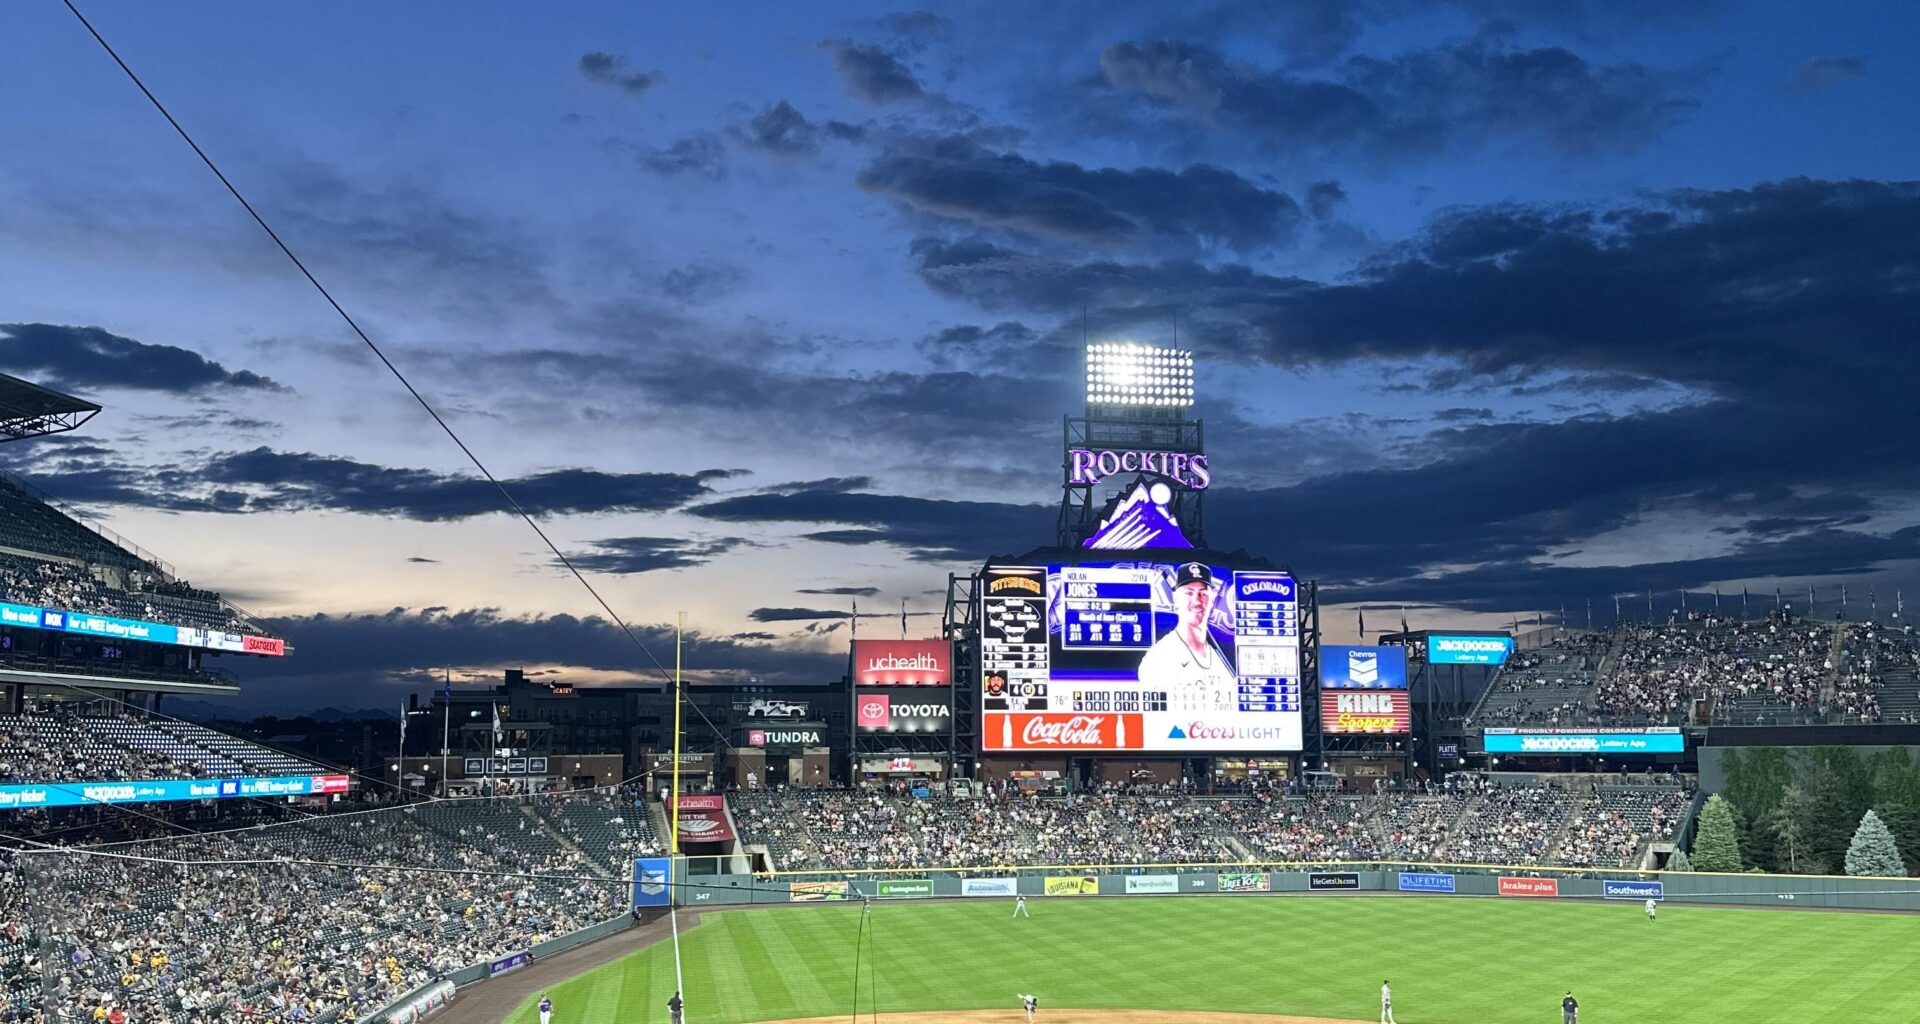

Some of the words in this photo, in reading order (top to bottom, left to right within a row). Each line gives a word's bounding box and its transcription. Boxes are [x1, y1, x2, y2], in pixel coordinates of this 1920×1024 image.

[1069, 449, 1211, 489] ROCKIES
[1067, 572, 1087, 581] NOLAN
[990, 576, 1041, 594] PITTSBURGH
[1067, 583, 1097, 597] JONES
[1242, 581, 1290, 596] COLORADO
[87, 618, 106, 631] FREE
[249, 639, 277, 652] SEATGEEK
[870, 652, 937, 670] uchealth
[1455, 654, 1475, 662] Lottery
[890, 704, 950, 717] TOYOTA
[1337, 695, 1394, 713] KING
[1338, 714, 1395, 729] Soopers
[1023, 716, 1103, 745] Coca-Cola
[1188, 720, 1235, 740] Coors
[1238, 728, 1281, 739] LIGHT
[764, 732, 820, 743] TUNDRA
[1601, 739, 1628, 748] Lottery
[1630, 739, 1646, 748] App
[1438, 745, 1457, 753] PLATTE
[691, 829, 724, 837] CHARITY
[1047, 881, 1079, 894] LOUISIANA
[1223, 879, 1241, 889] TREE
[1242, 876, 1258, 885] TOP
[1409, 877, 1453, 885] LIFETIME
[1502, 881, 1533, 890] brakes
[1607, 886, 1653, 895] Southwest
